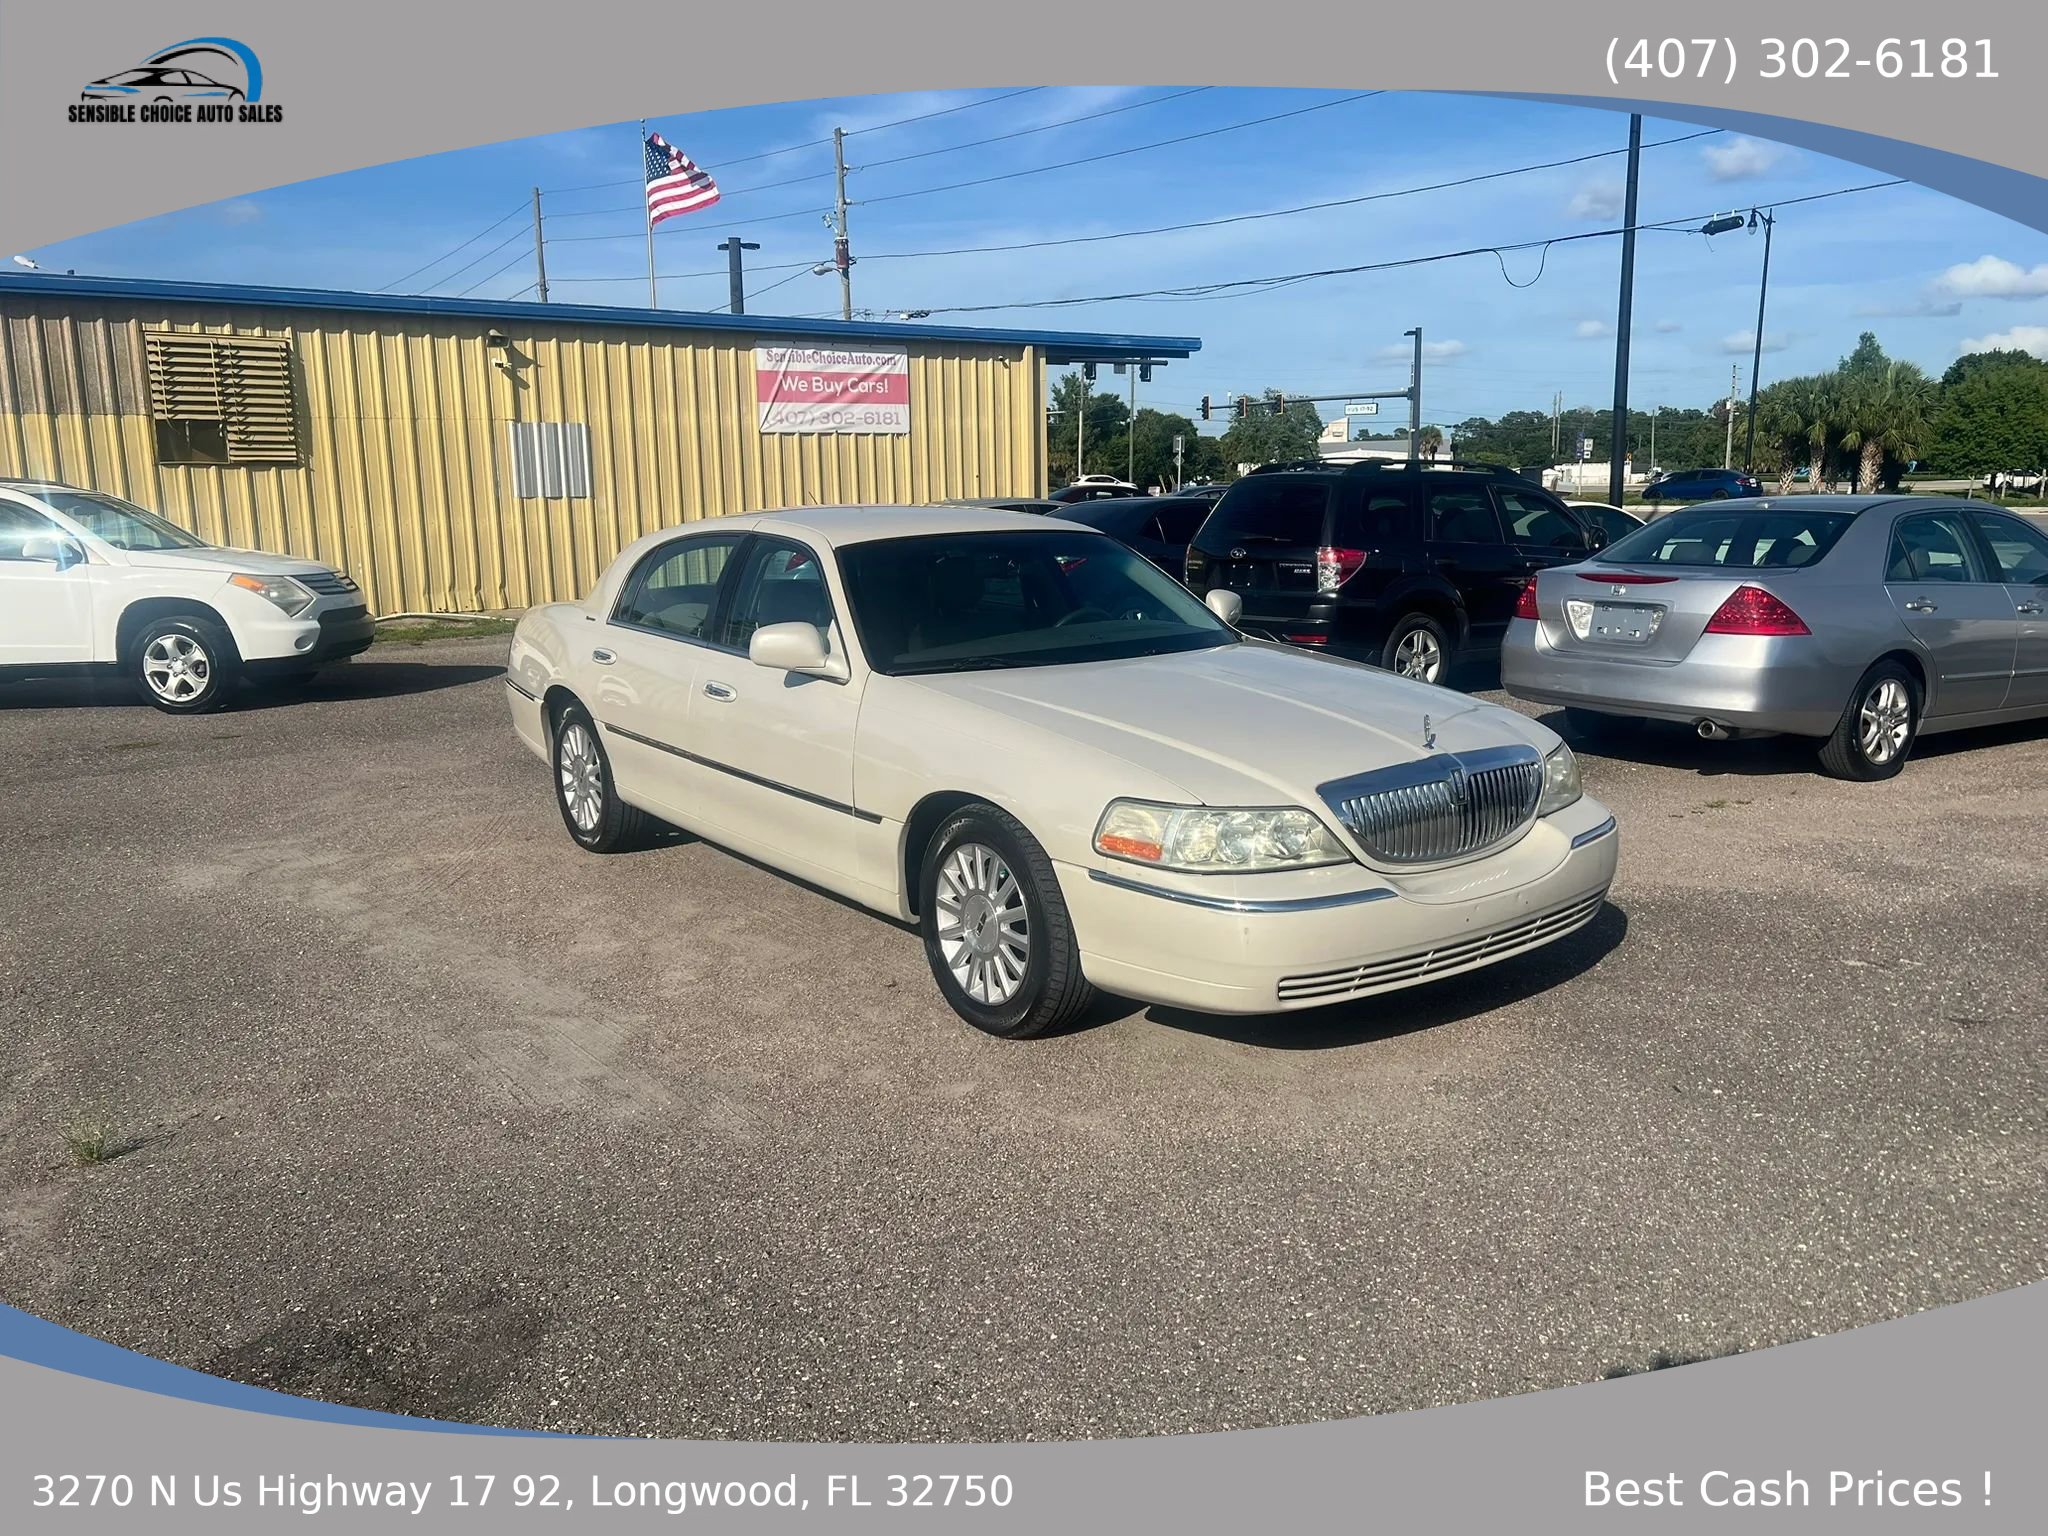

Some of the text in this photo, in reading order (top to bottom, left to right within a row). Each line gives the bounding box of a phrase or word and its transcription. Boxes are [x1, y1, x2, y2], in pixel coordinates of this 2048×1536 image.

[782, 375, 889, 396] We Buy Cars!
[819, 411, 901, 425] 302-6181
